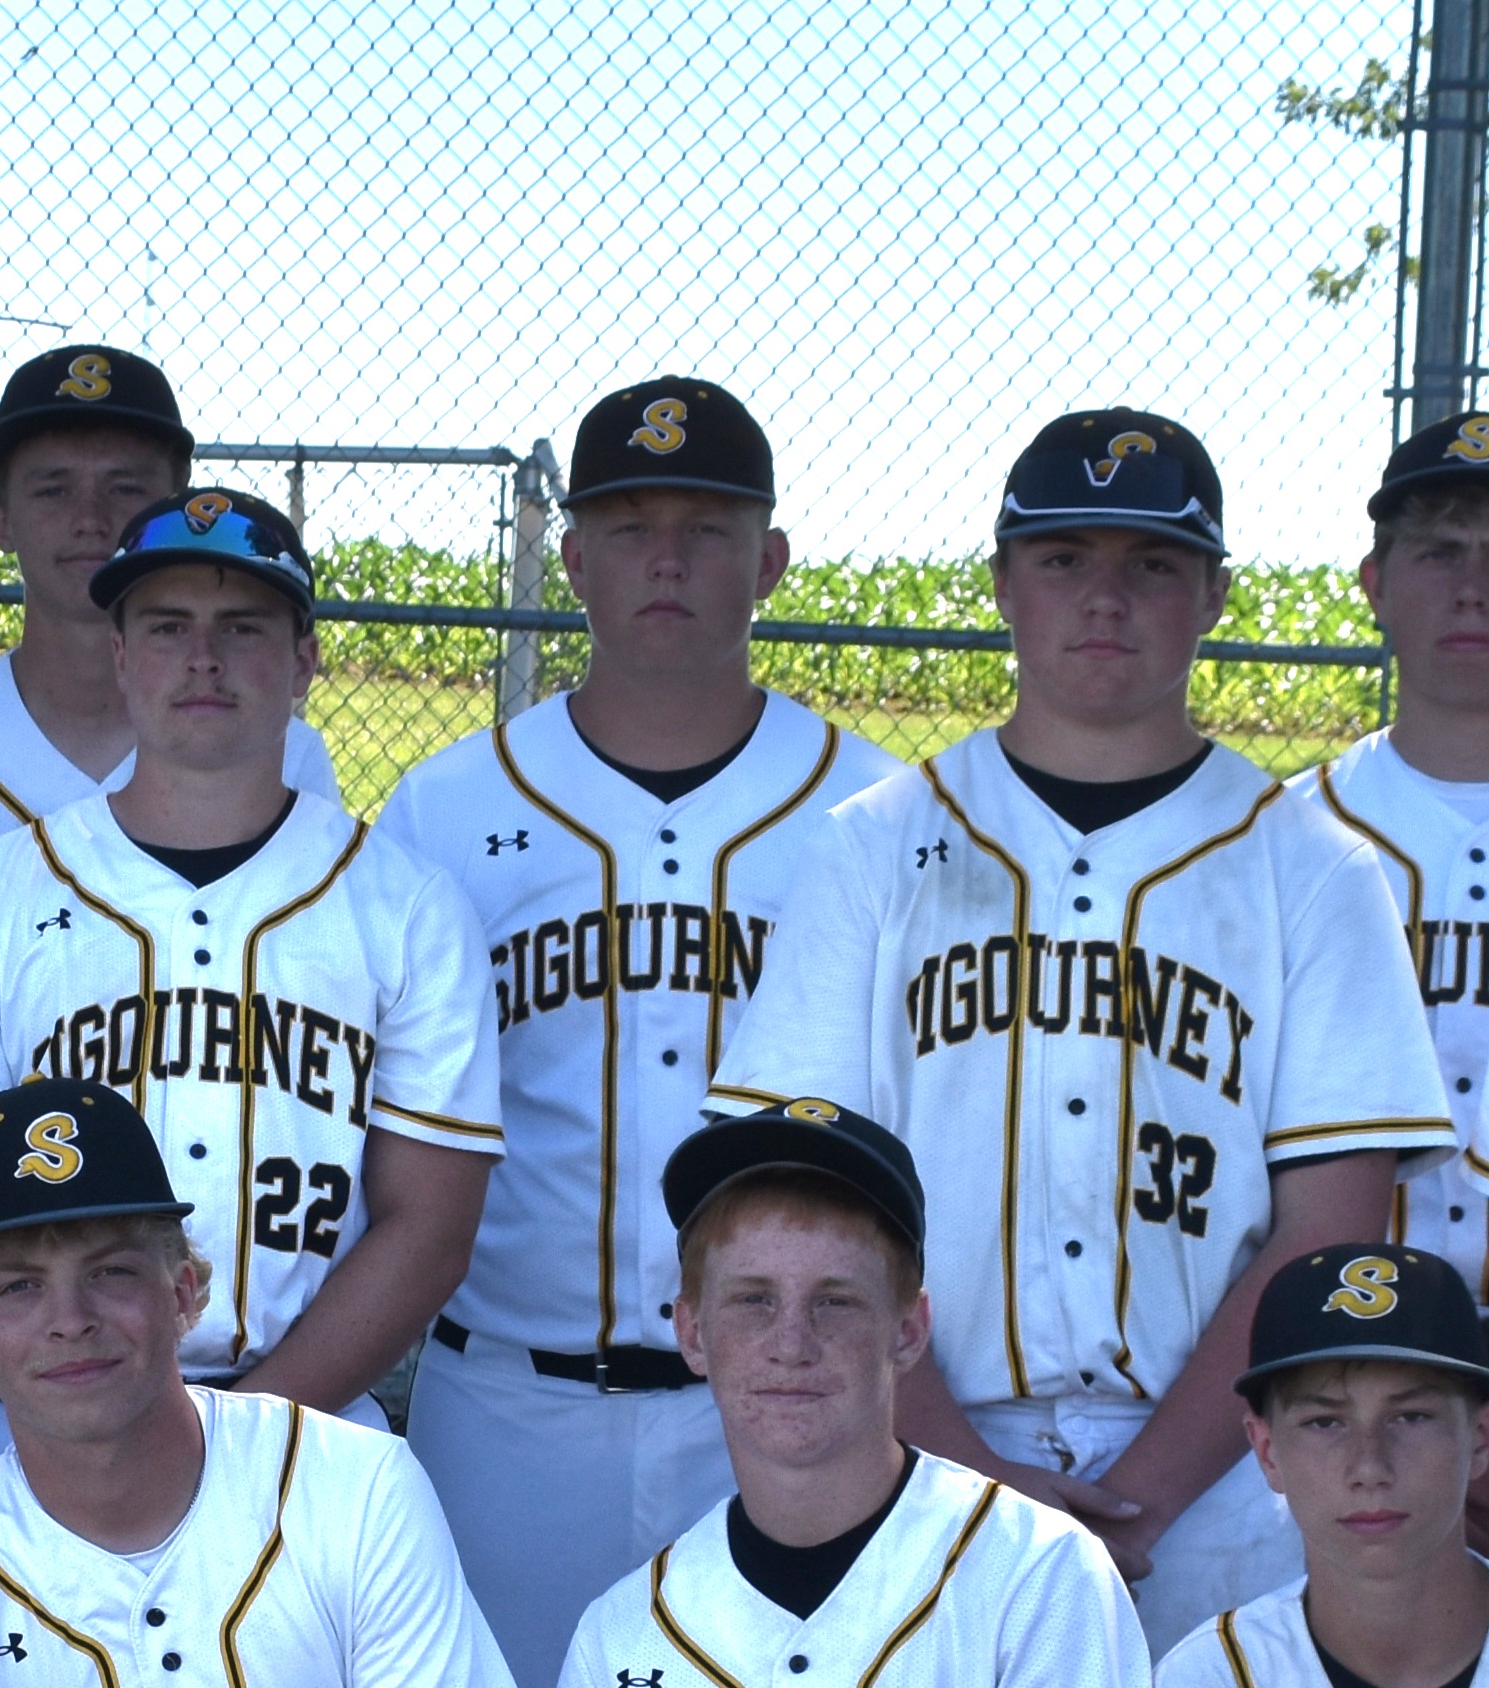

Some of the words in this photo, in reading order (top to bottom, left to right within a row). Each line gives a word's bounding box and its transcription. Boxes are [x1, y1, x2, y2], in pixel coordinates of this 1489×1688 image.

[55, 353, 112, 400] S
[627, 398, 688, 455] S
[13, 1110, 84, 1185] S
[1132, 1120, 1218, 1240] 32
[254, 1155, 352, 1260] 22
[1321, 1254, 1400, 1321] S
